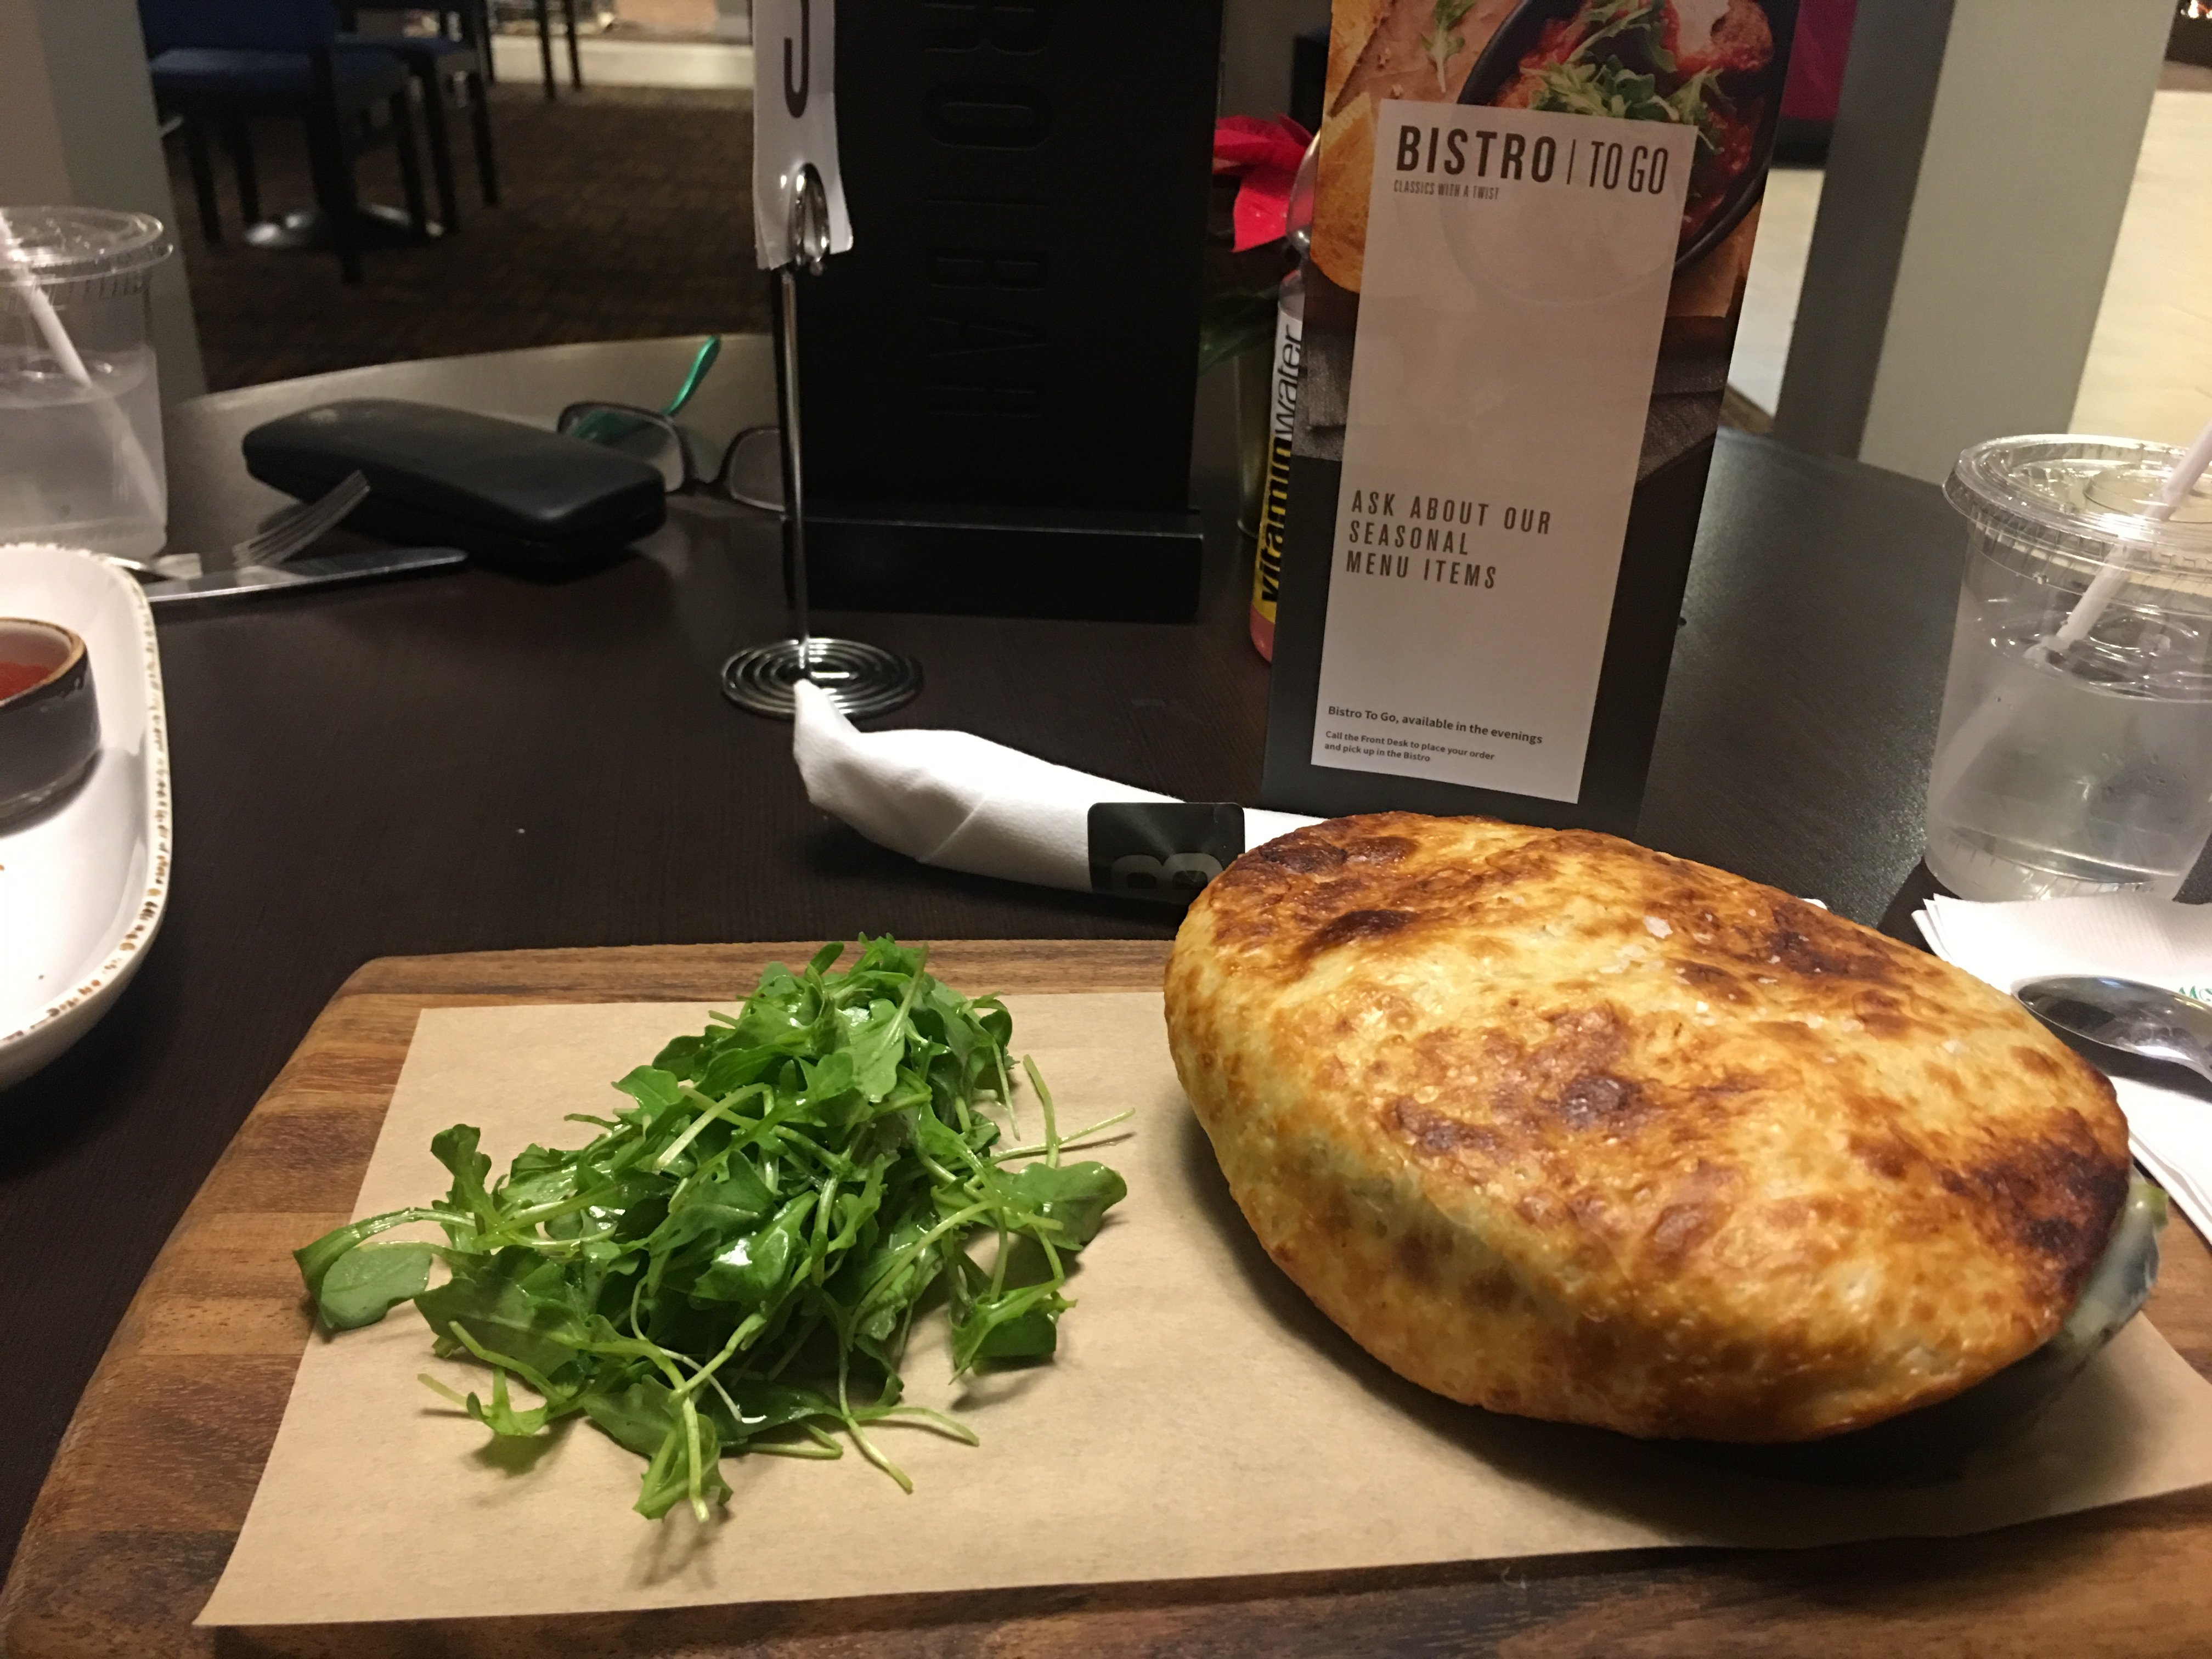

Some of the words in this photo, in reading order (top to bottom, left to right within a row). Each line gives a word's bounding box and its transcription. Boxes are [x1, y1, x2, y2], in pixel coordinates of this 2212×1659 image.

[1396, 125, 1557, 183] BISTRO
[1393, 179, 1435, 195] CLASSICS
[1437, 183, 1461, 198] WITH
[1462, 185, 1469, 198] A
[1472, 185, 1499, 200] TWIST
[1351, 489, 1395, 516] ASK
[1410, 496, 1489, 526] ABOUT
[1504, 507, 1551, 534] OUR
[1349, 520, 1469, 555] SEASONAL
[1346, 550, 1409, 578] MENU
[1424, 558, 1497, 589] ITEMS
[1328, 706, 1362, 719] Bistro
[1364, 710, 1378, 720] To
[1380, 712, 1400, 724] Go,
[1402, 716, 1454, 731] available
[1455, 721, 1466, 732] in
[1469, 724, 1489, 736] the
[1491, 729, 1543, 745] evenings
[1324, 742, 1341, 751] and
[1342, 745, 1362, 754] pick
[1363, 748, 1375, 757] up
[1376, 748, 1385, 757] in
[1387, 750, 1402, 758] the
[1403, 752, 1431, 762] Bistro
[1325, 730, 1342, 740] Call
[1344, 733, 1359, 742] the
[1361, 735, 1385, 745] Front
[1387, 738, 1409, 748] Desk
[1421, 743, 1446, 753] place
[1447, 747, 1468, 755] your
[1469, 750, 1496, 760] order
